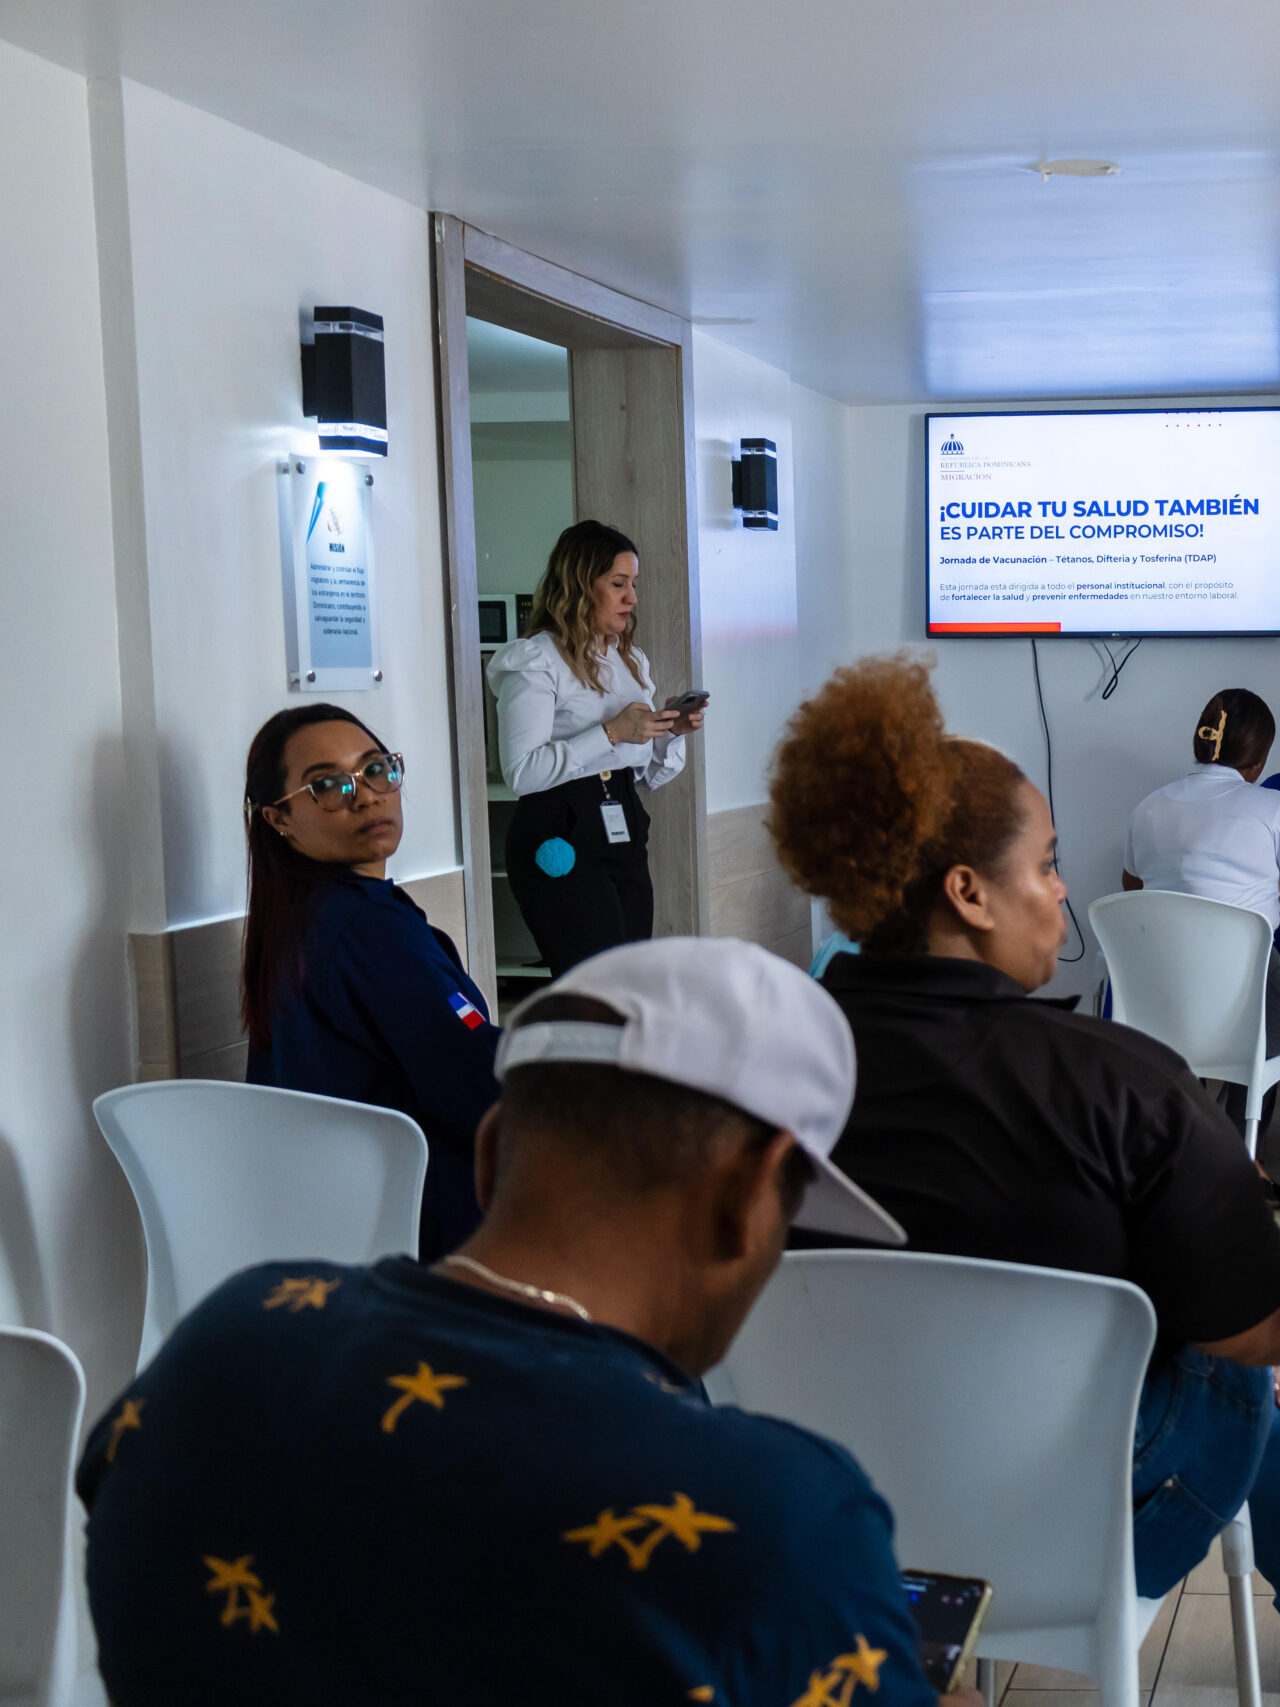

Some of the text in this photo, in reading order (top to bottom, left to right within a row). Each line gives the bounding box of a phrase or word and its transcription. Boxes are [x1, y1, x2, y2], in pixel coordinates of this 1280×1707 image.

[940, 494, 1260, 522] ¡CUIDAR TU SALUD TAMBIÉN
[940, 524, 1204, 540] ES PARTE DEL COMPROMISO!
[939, 556, 977, 565] Jornada
[979, 556, 991, 564] de
[993, 555, 1047, 564] Vacunación
[1055, 555, 1094, 564] Tétanos,
[1096, 554, 1130, 563] Difteria
[1131, 556, 1138, 564] y
[1139, 554, 1182, 563] Tosferina
[1184, 554, 1217, 564] (TDAP)
[940, 583, 957, 591] Esta
[957, 583, 989, 592] jornada
[1008, 582, 1039, 591] dirigida
[1067, 582, 1075, 590] el
[1076, 582, 1112, 591] personal
[940, 593, 951, 601] de
[951, 593, 991, 601] fortalecer
[992, 593, 1000, 601] la
[1001, 593, 1024, 601] salud
[1032, 592, 1066, 602] prevenir
[1068, 592, 1129, 600] enfermedades
